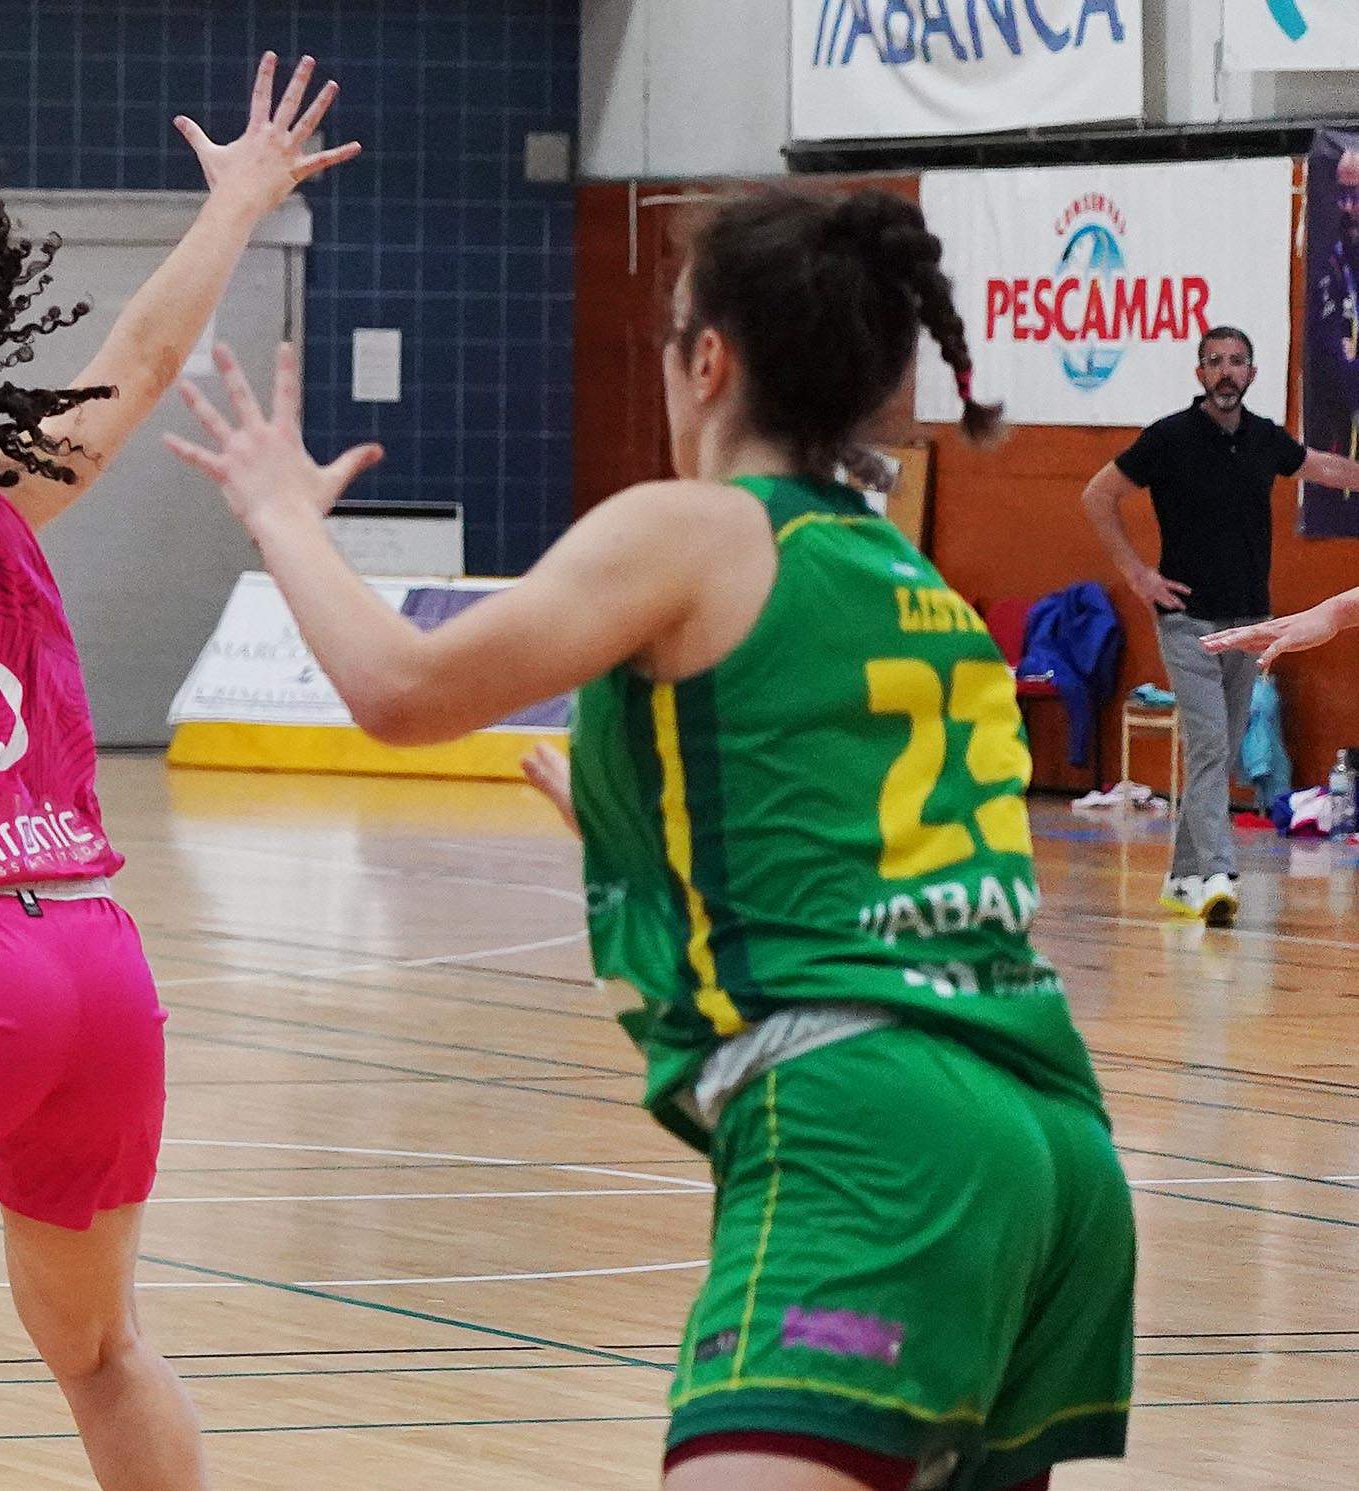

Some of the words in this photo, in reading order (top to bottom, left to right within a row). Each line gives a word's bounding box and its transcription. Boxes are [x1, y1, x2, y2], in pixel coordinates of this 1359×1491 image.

[986, 277, 1210, 341] PESCAMAR
[894, 585, 989, 634] LIST
[865, 657, 1033, 880] 23
